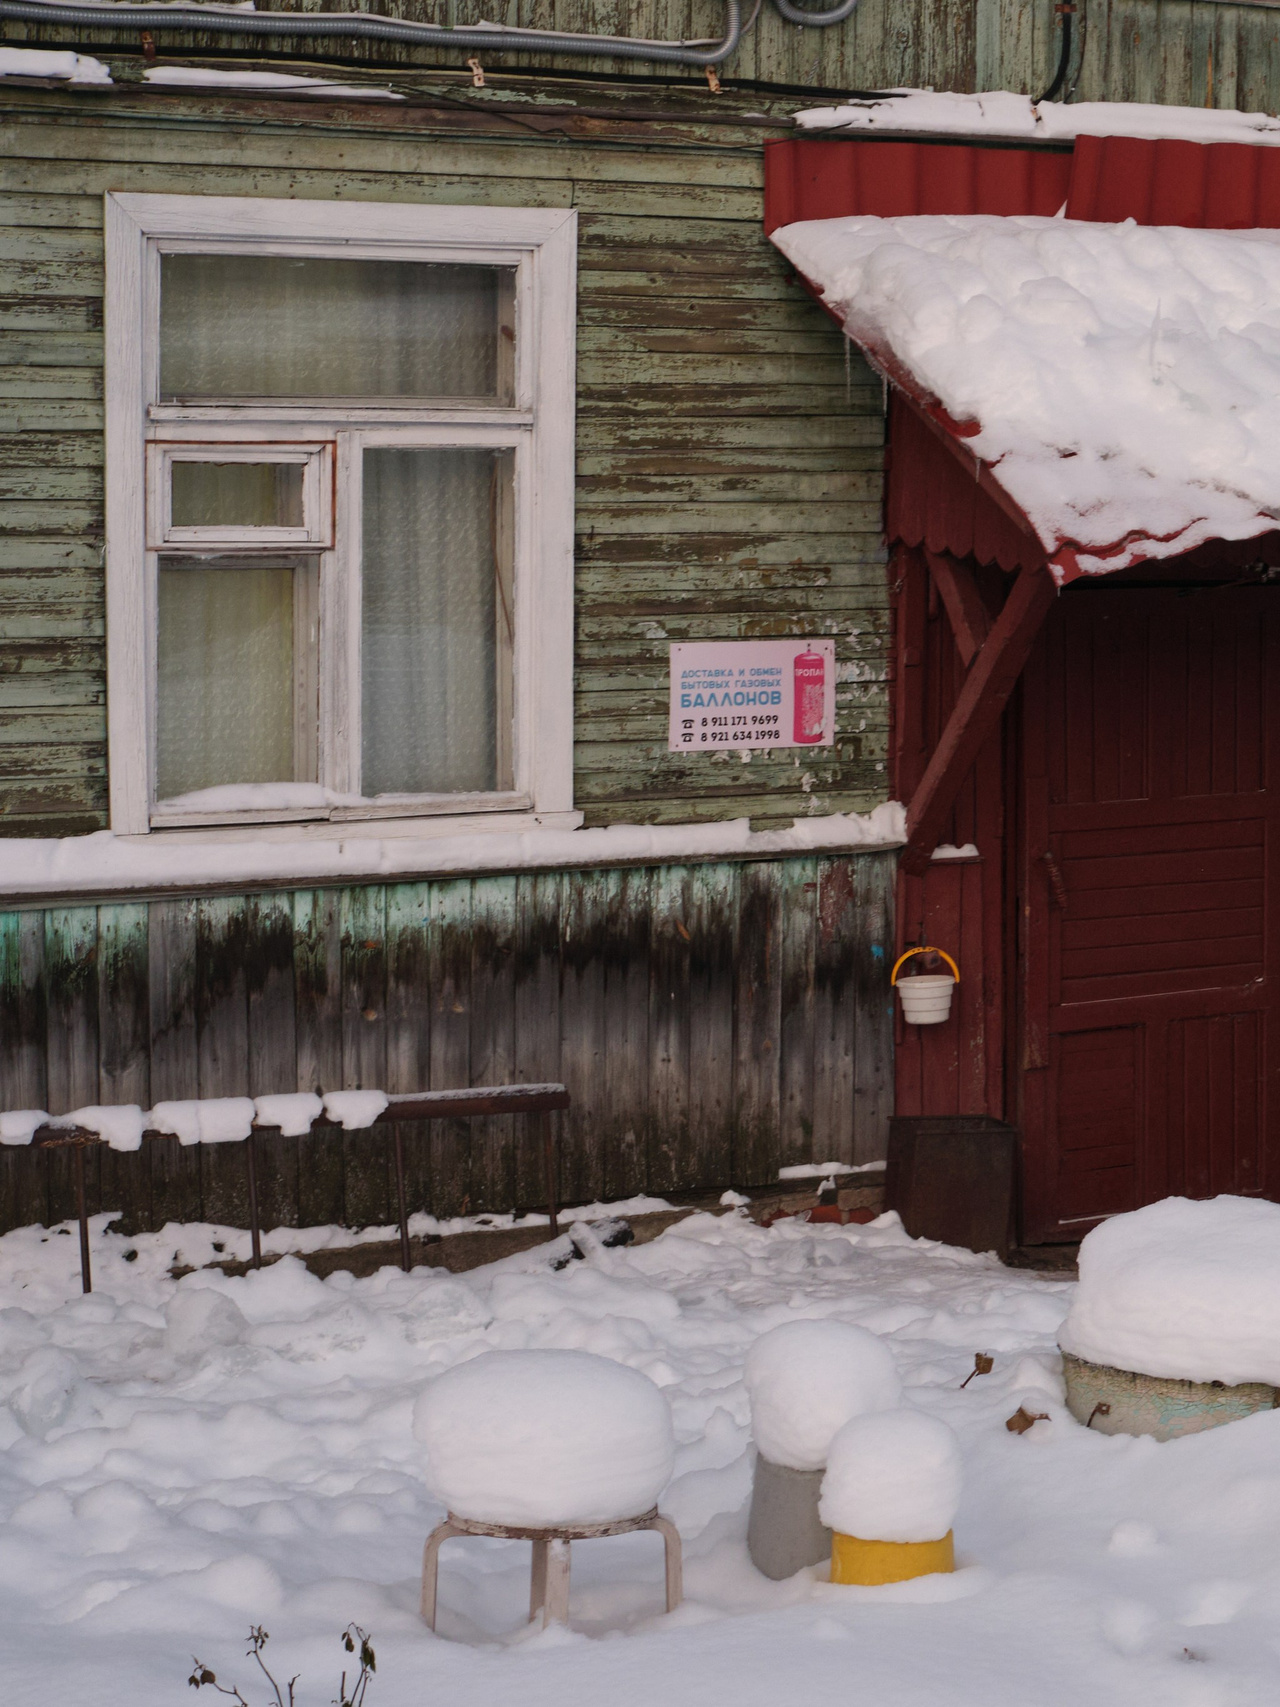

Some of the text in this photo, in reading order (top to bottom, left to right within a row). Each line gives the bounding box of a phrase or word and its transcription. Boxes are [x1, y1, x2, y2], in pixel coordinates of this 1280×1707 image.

[681, 667, 782, 679] ДОСТАВКА И ОБМЕН
[681, 679, 781, 690] БЫТОВЫХ ГАЗОВЫХ
[681, 691, 781, 708] БАЛЛОНОВ
[701, 715, 779, 727] 8 911 171 9699
[701, 730, 780, 742] 8 921 634 1998
